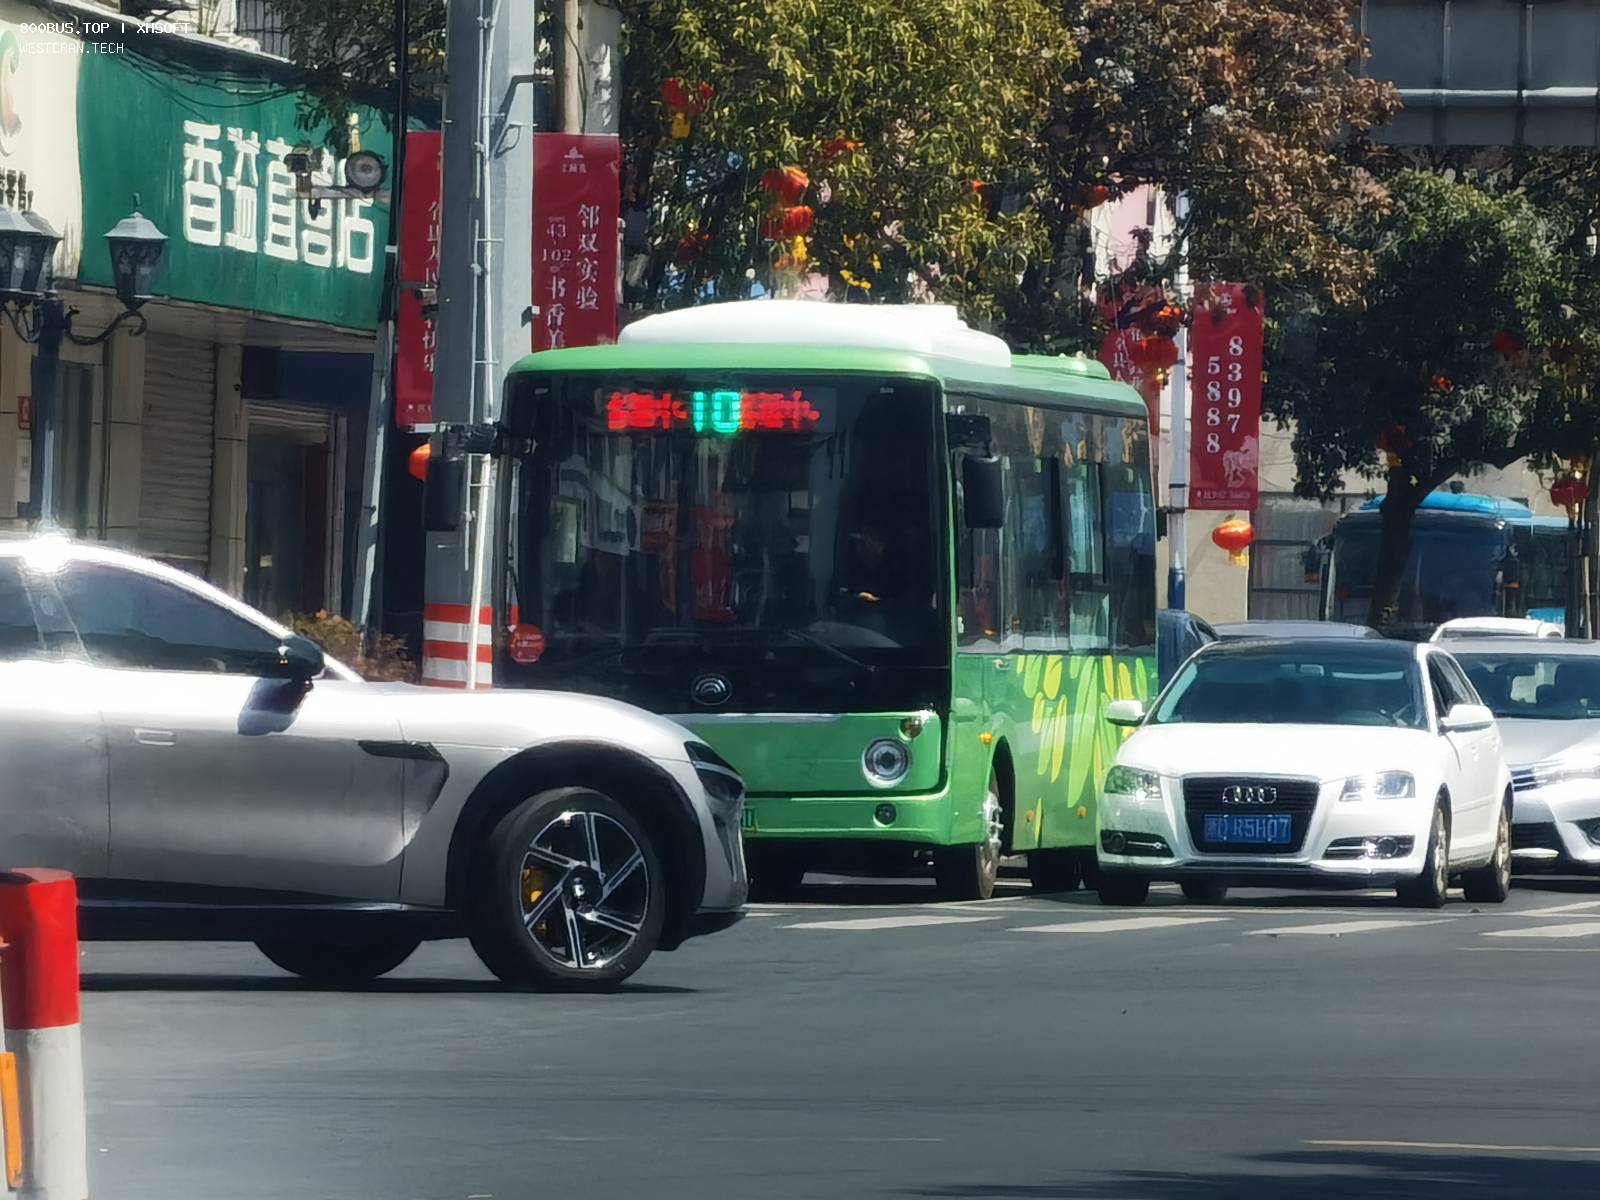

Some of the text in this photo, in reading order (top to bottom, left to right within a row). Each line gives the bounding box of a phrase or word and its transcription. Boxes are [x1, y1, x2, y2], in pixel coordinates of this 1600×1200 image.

[693, 391, 740, 433] 10
[1207, 356, 1221, 453] 5888
[1227, 336, 1243, 434] 8397
